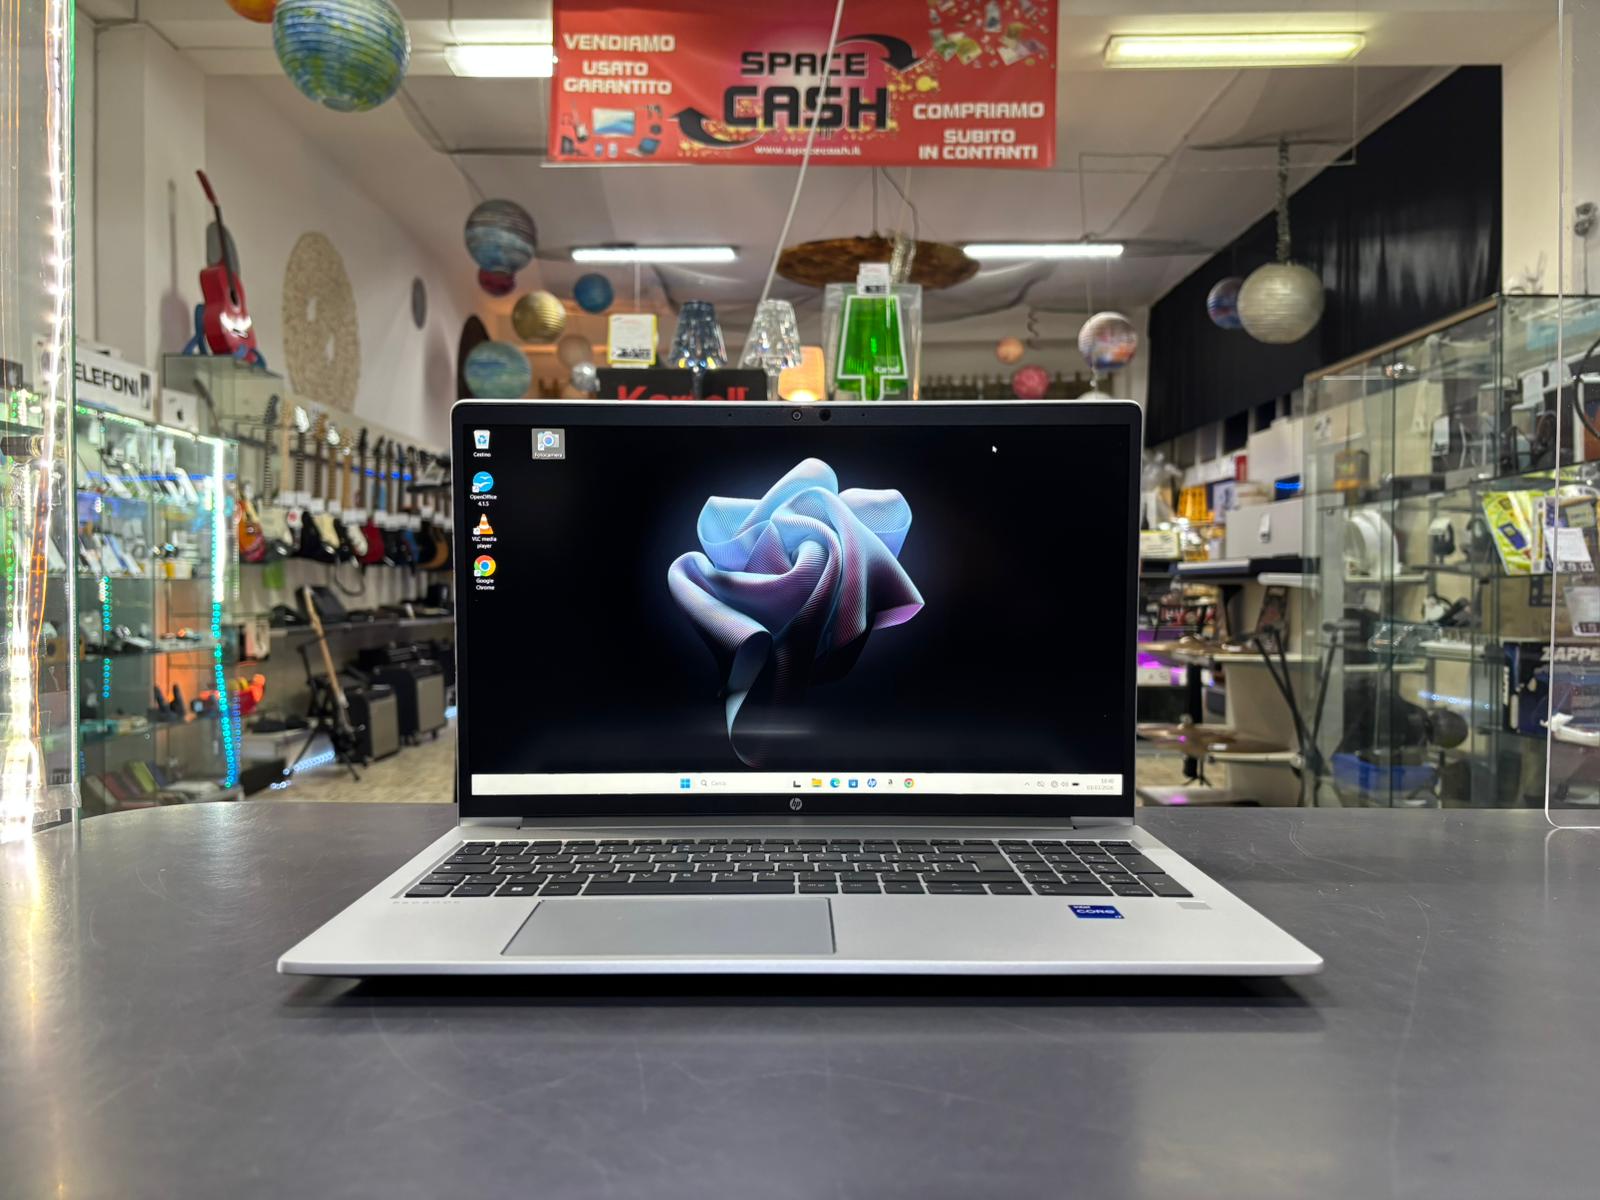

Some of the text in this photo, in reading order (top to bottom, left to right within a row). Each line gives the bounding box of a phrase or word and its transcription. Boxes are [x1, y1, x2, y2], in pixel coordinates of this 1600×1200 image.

[563, 33, 675, 52] VENDIAMO
[583, 61, 648, 76] USATO
[741, 52, 867, 76] SPACE
[563, 78, 672, 95] GARANTITO
[724, 86, 887, 129] CASH
[913, 102, 1045, 119] COMPRIAMO
[944, 129, 1016, 144] SUBITO
[918, 145, 1038, 160] IN CONTANTI
[74, 361, 139, 397] ELEFONI
